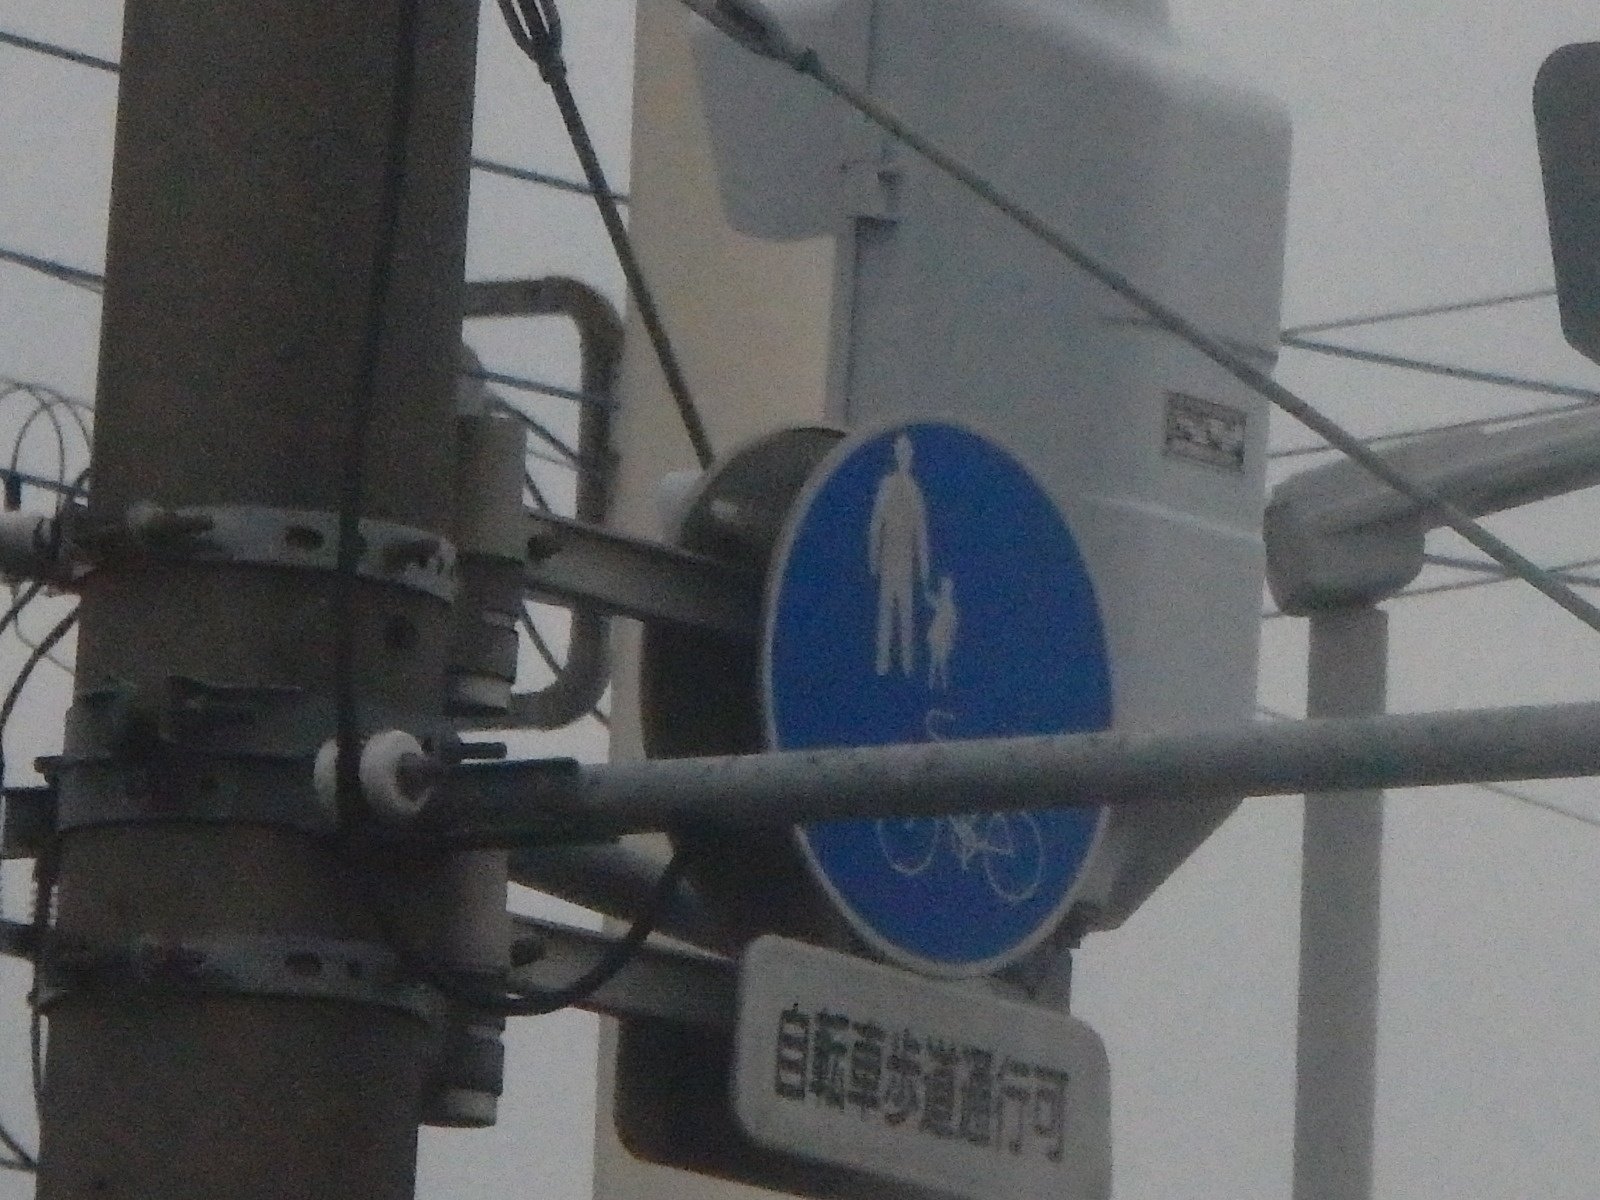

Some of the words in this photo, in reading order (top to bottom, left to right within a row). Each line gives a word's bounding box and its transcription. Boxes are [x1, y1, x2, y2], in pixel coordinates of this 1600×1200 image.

[775, 1002, 1069, 1162] 自転車歩道通行可
